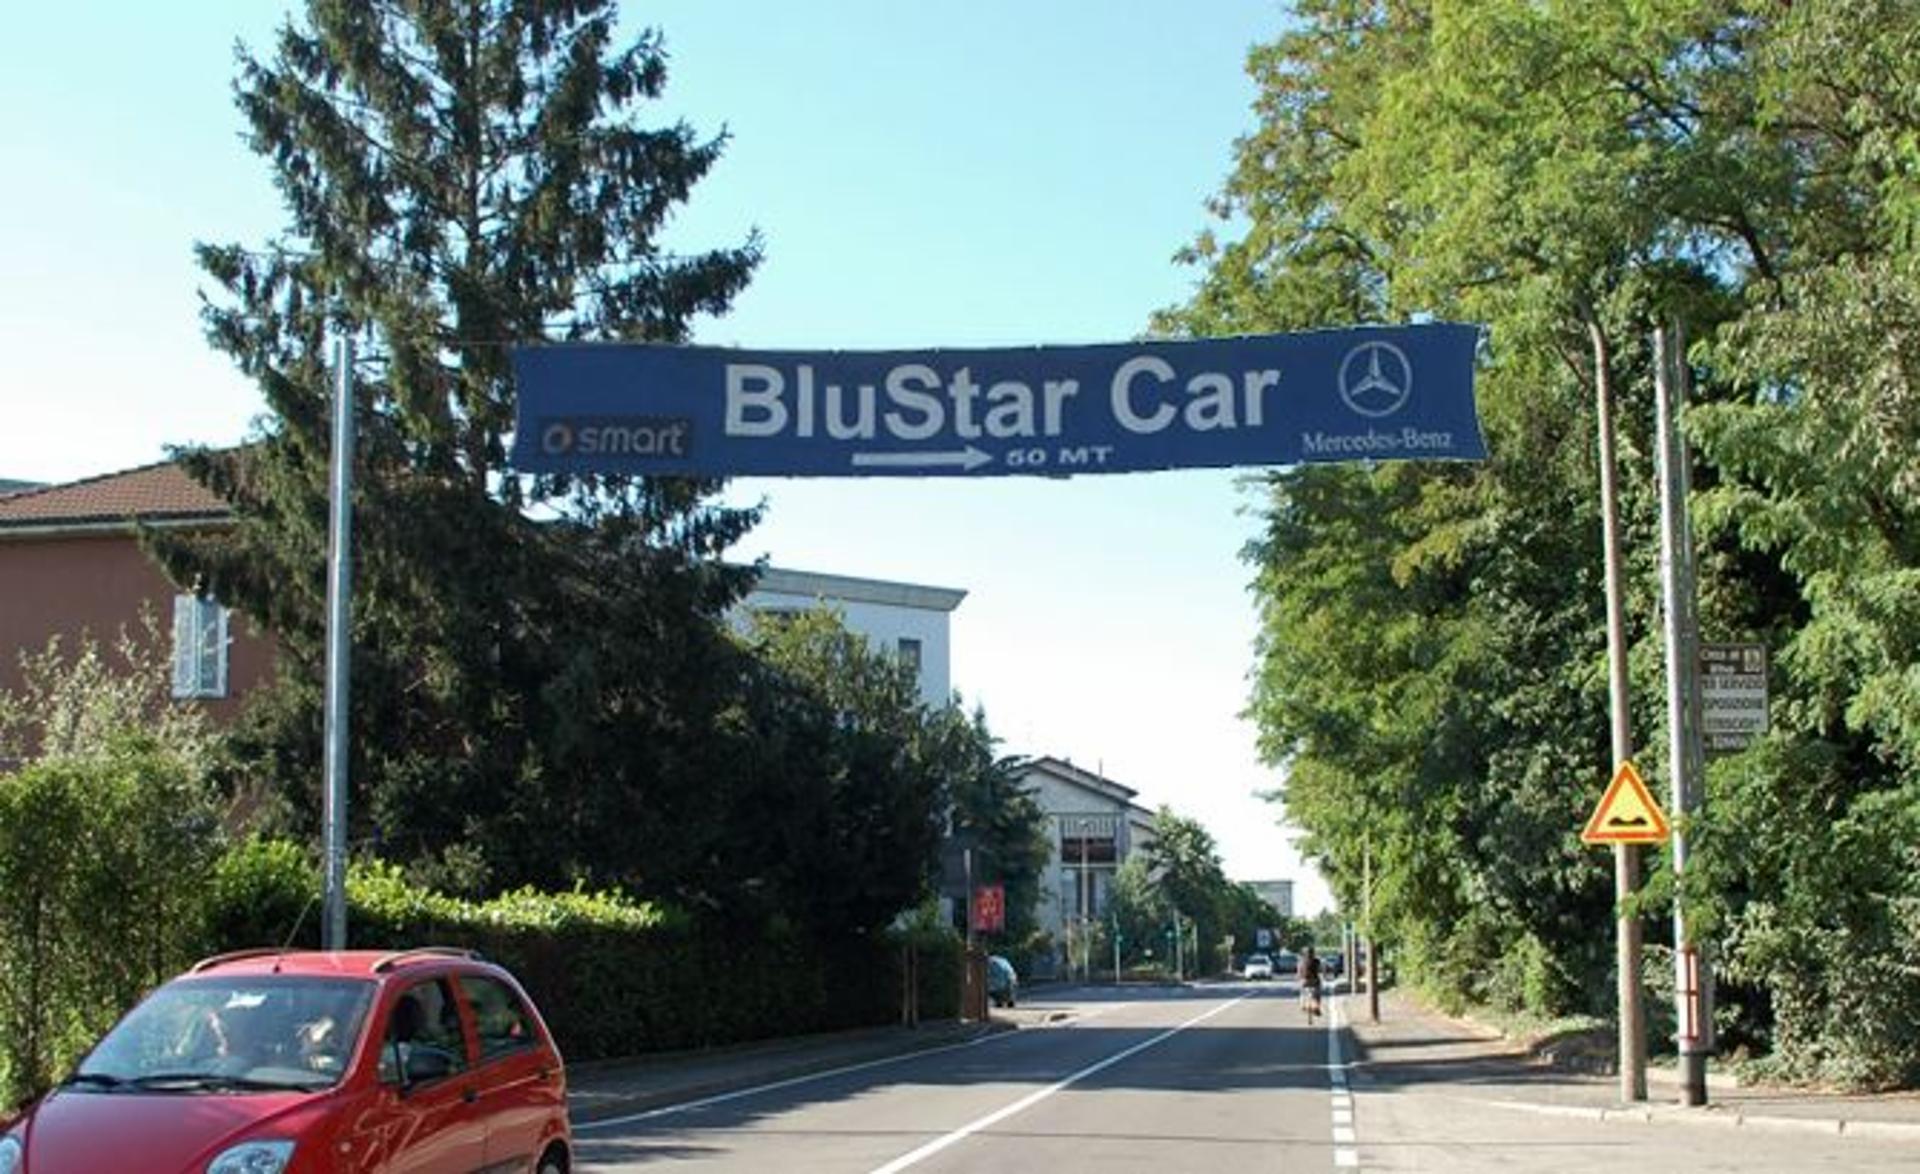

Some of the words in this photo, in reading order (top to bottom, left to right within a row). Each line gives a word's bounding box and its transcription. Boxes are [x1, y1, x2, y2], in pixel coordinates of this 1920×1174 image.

[725, 364, 1079, 440] BluStar
[1110, 356, 1280, 434] Car
[577, 422, 683, 455] smart
[1302, 427, 1453, 451] Mercedes-Benz
[1059, 445, 1115, 464] MT
